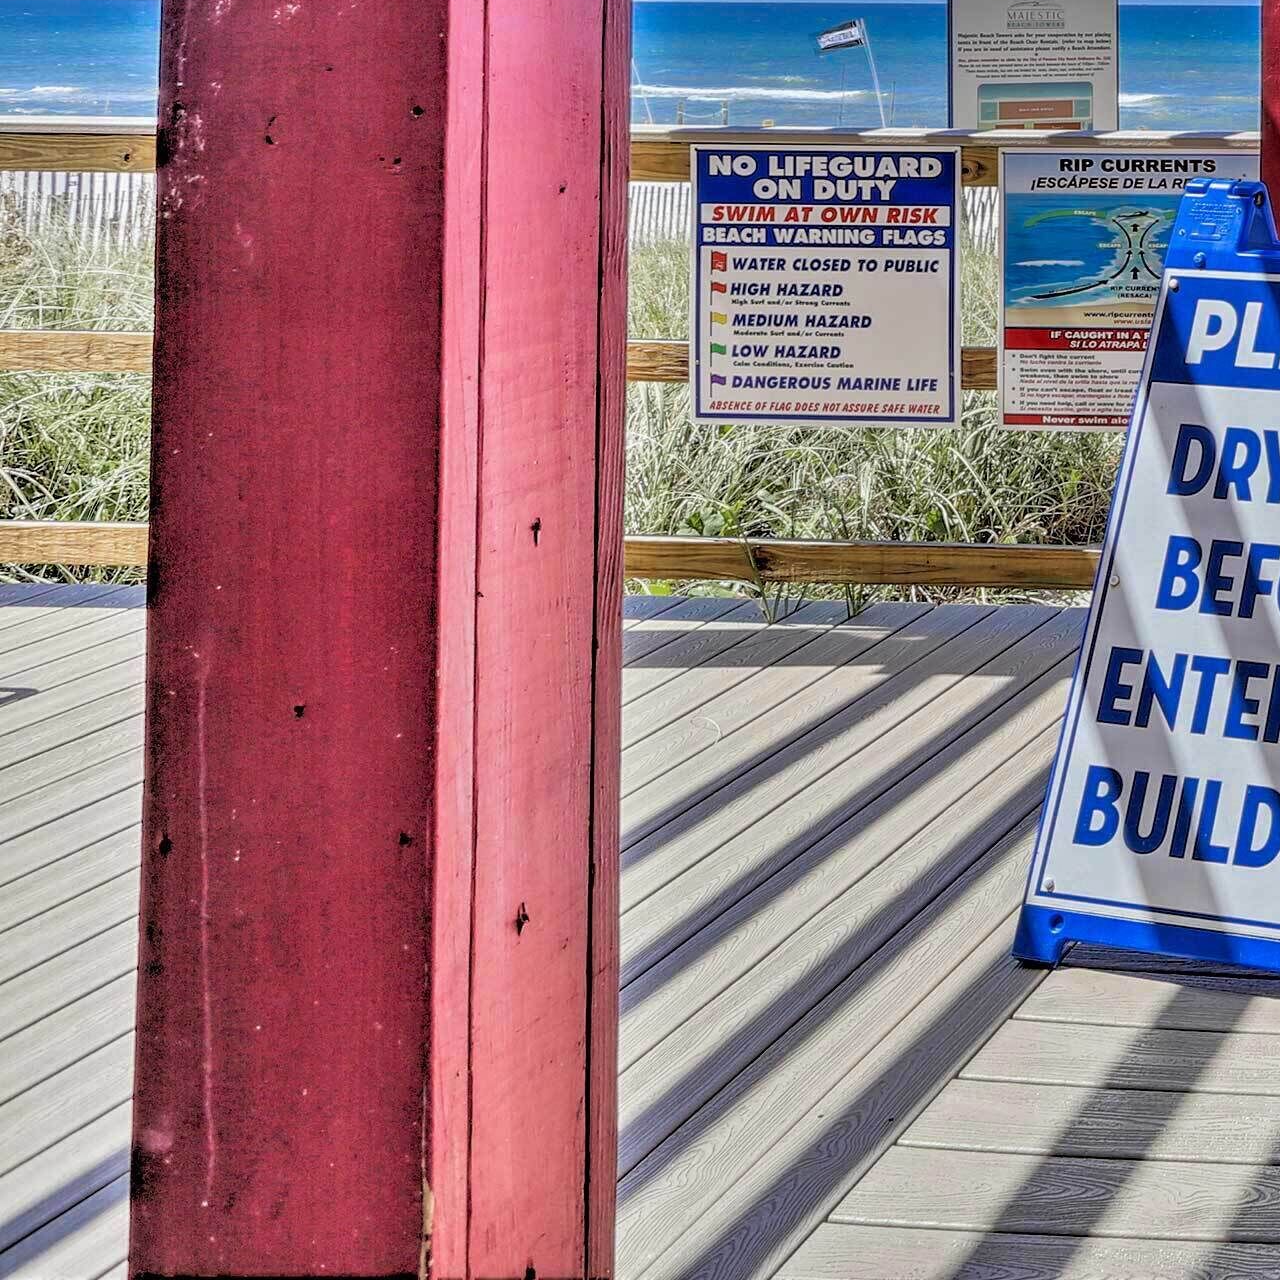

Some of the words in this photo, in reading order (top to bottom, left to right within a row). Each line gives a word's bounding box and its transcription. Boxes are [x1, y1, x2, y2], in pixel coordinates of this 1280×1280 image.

[1007, 11, 1065, 20] MAJESTIC
[708, 154, 756, 176] NO
[769, 155, 942, 178] LIFEGUARD
[1059, 158, 1094, 172] RIP
[1101, 159, 1217, 172] CURRENTS
[753, 178, 801, 200] ON
[814, 178, 896, 201] DUTY
[1031, 175, 1118, 190] ¡ESCÁPESE
[1123, 178, 1144, 189] DE
[1148, 178, 1167, 189] LA
[712, 205, 776, 222] SWIM
[784, 207, 814, 223] AT
[821, 207, 877, 224] OWN
[886, 208, 939, 224] RISK
[702, 227, 767, 244] BEACH
[774, 227, 875, 245] WARNING
[882, 228, 946, 246] FLAGS
[732, 257, 786, 271] WATER
[792, 257, 851, 272] CLOSED
[857, 259, 878, 272] TO
[883, 259, 939, 273] PUBLIC
[730, 283, 771, 296] HIGH
[776, 283, 843, 297] HAZARD
[795, 299, 818, 307] Strong
[732, 314, 798, 328] MEDIUM
[805, 315, 872, 329] HAZARD
[1050, 331, 1061, 340] IF
[1064, 331, 1113, 340] CAUGHT
[1116, 331, 1130, 340] IN
[1132, 332, 1141, 340] A
[732, 345, 769, 358] LOW
[774, 345, 841, 359] HAZARD
[731, 375, 831, 390] DANGEROUS
[837, 377, 900, 391] MARINE
[906, 378, 938, 392] LIFE
[709, 401, 753, 411] ABSENCE
[755, 401, 767, 411] OF
[769, 402, 791, 411] FLAG
[794, 402, 820, 412] DOES
[822, 402, 841, 412] NOT
[842, 403, 880, 413] ASSURE
[882, 404, 905, 413] SAFE
[908, 404, 941, 414] WATER
[1042, 416, 1076, 424] Never
[1078, 416, 1108, 424] swim
[1110, 416, 1128, 424] alo
